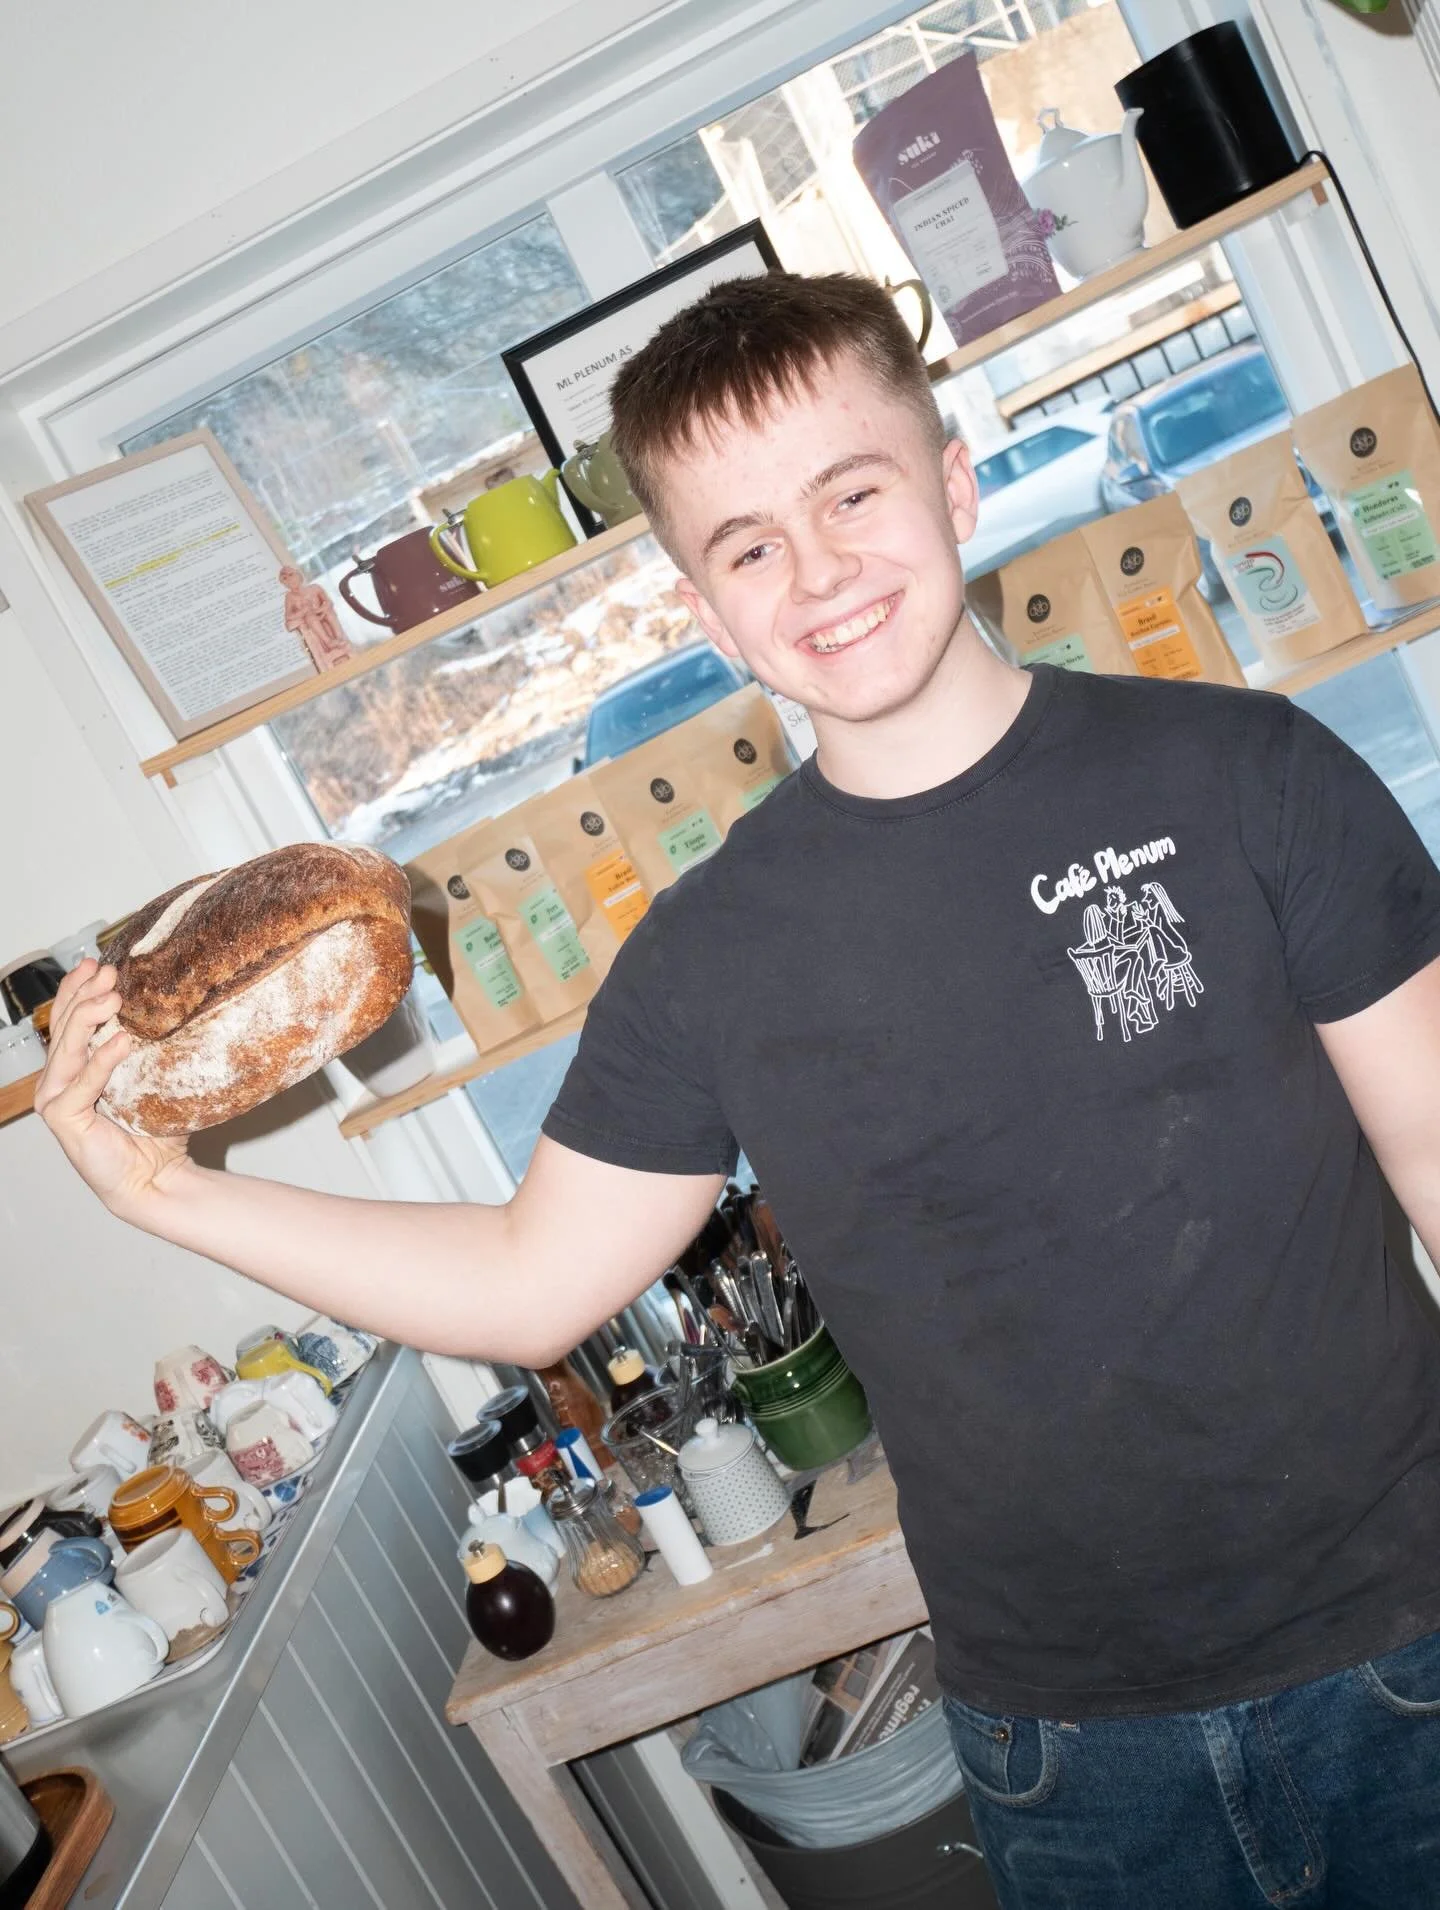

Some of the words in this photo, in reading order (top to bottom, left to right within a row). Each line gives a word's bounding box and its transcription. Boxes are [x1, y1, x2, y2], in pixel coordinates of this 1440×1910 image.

[898, 131, 941, 166] suki
[914, 212, 942, 232] INDIAN
[941, 197, 970, 216] SPICED
[935, 215, 955, 230] CHAI
[556, 377, 574, 391] ML
[574, 353, 618, 382] PLENUM
[619, 345, 633, 358] AS
[1031, 863, 1097, 914] Café
[1094, 837, 1176, 883] Plenum
